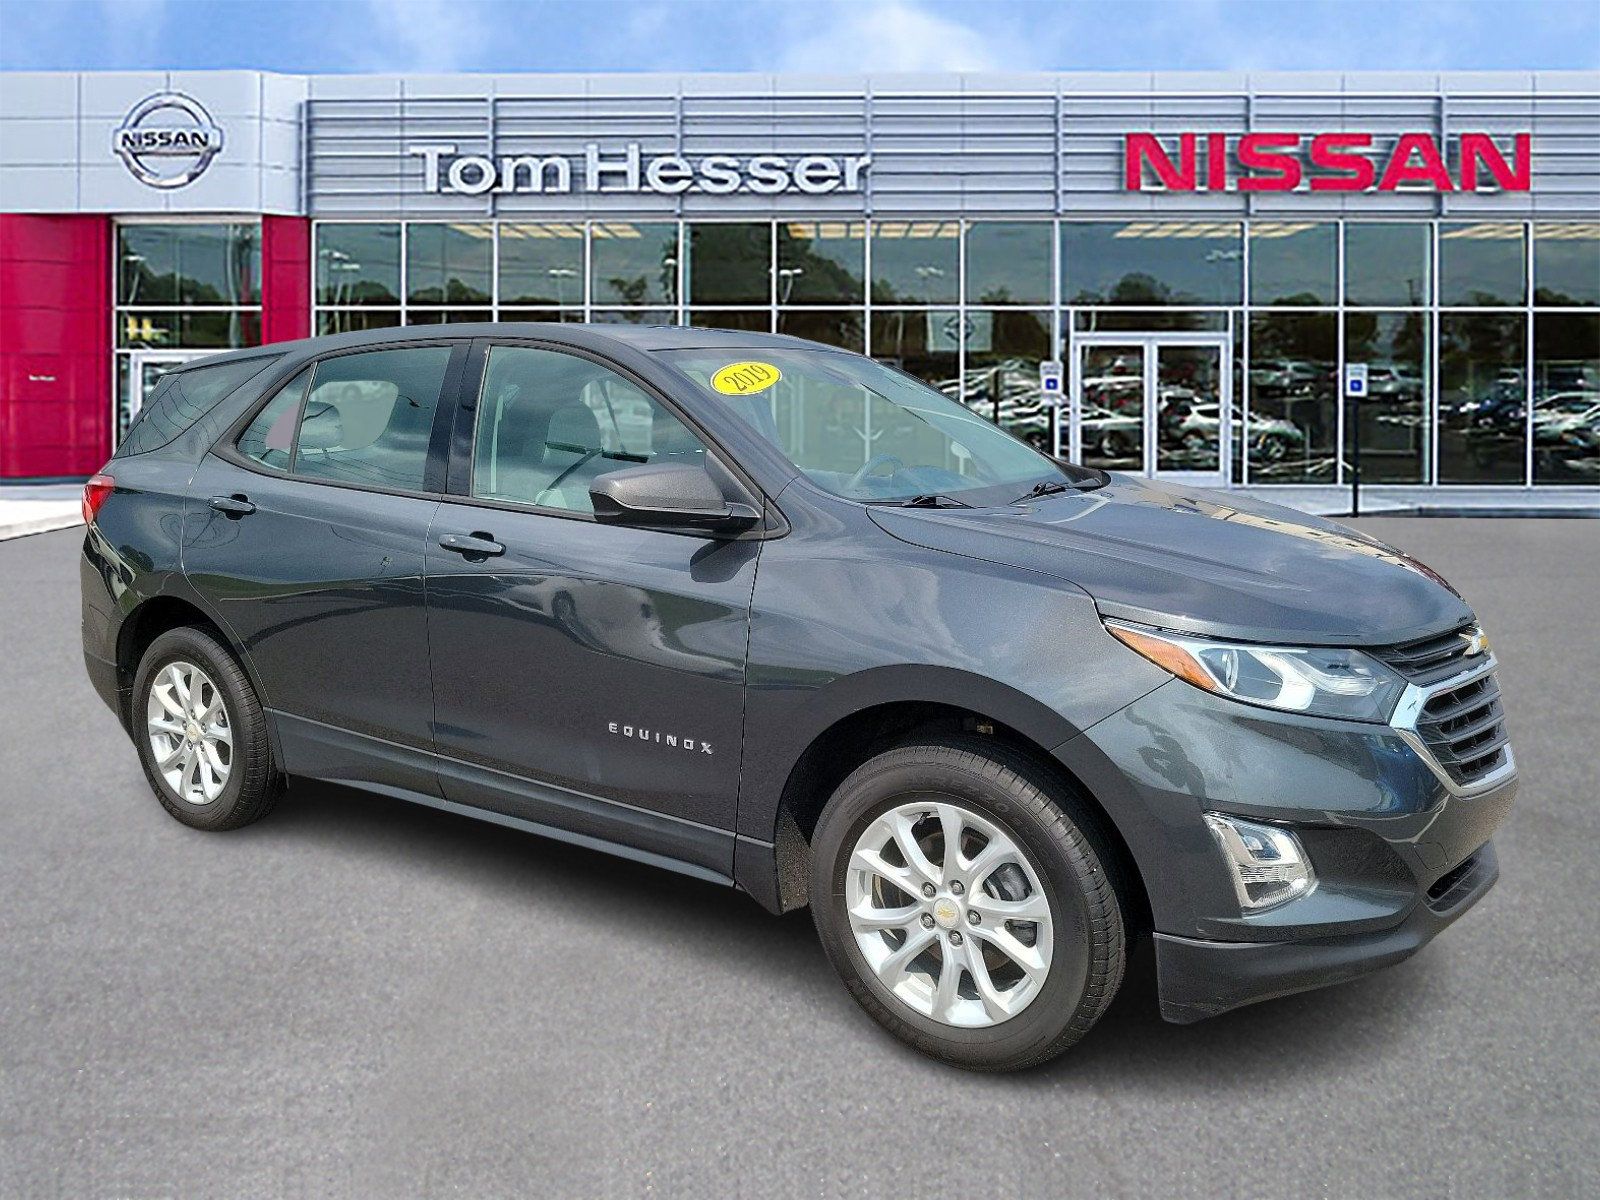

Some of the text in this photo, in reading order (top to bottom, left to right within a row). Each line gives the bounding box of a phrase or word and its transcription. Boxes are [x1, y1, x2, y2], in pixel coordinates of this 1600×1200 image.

[121, 131, 209, 147] NISSAN
[408, 143, 872, 194] Tom Hesser
[1125, 132, 1532, 191] NISSAN
[723, 365, 771, 391] 2019
[608, 722, 714, 755] EQUINOX
